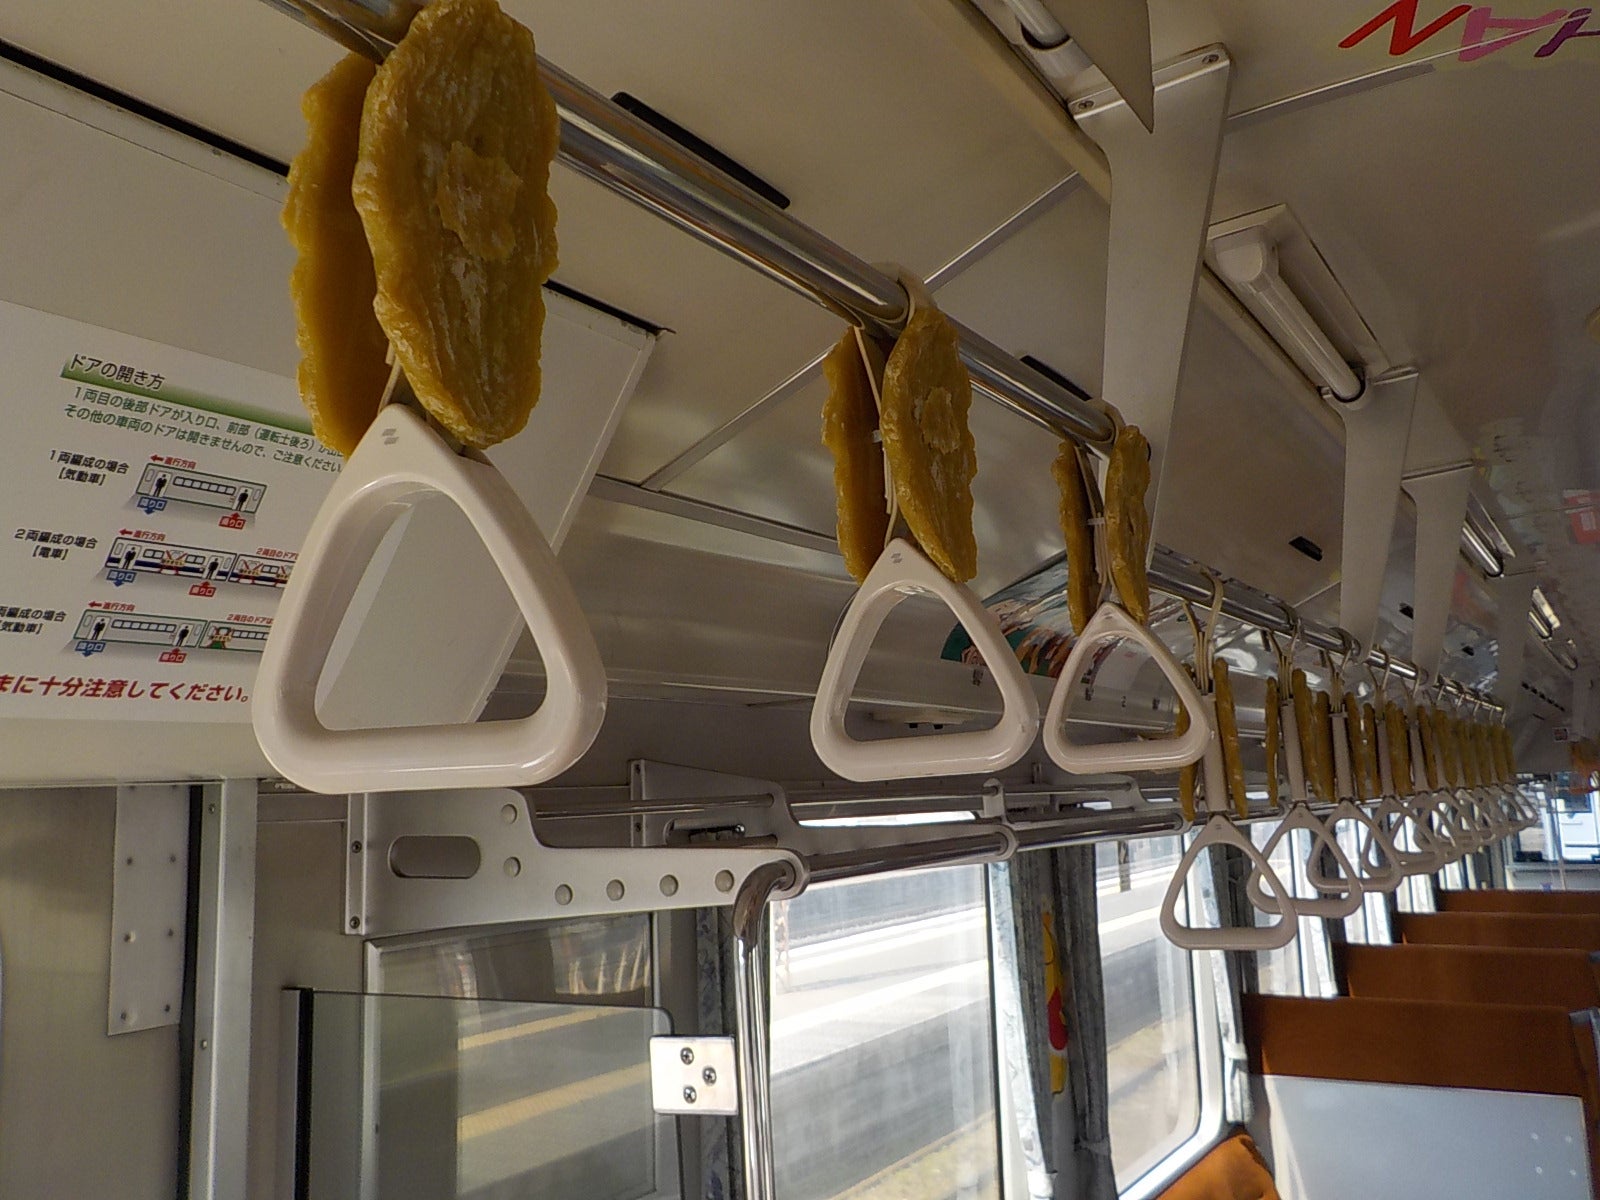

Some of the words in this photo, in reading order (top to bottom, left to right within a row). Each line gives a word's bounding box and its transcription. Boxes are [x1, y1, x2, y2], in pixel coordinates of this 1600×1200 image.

[70, 353, 165, 390] ドアの開き方
[49, 450, 130, 474] 1両編成の場合
[164, 456, 197, 470] 進行方向
[15, 528, 98, 550] 2両編成の場合
[132, 530, 167, 542] 進行方向
[102, 601, 136, 612] 進行方向
